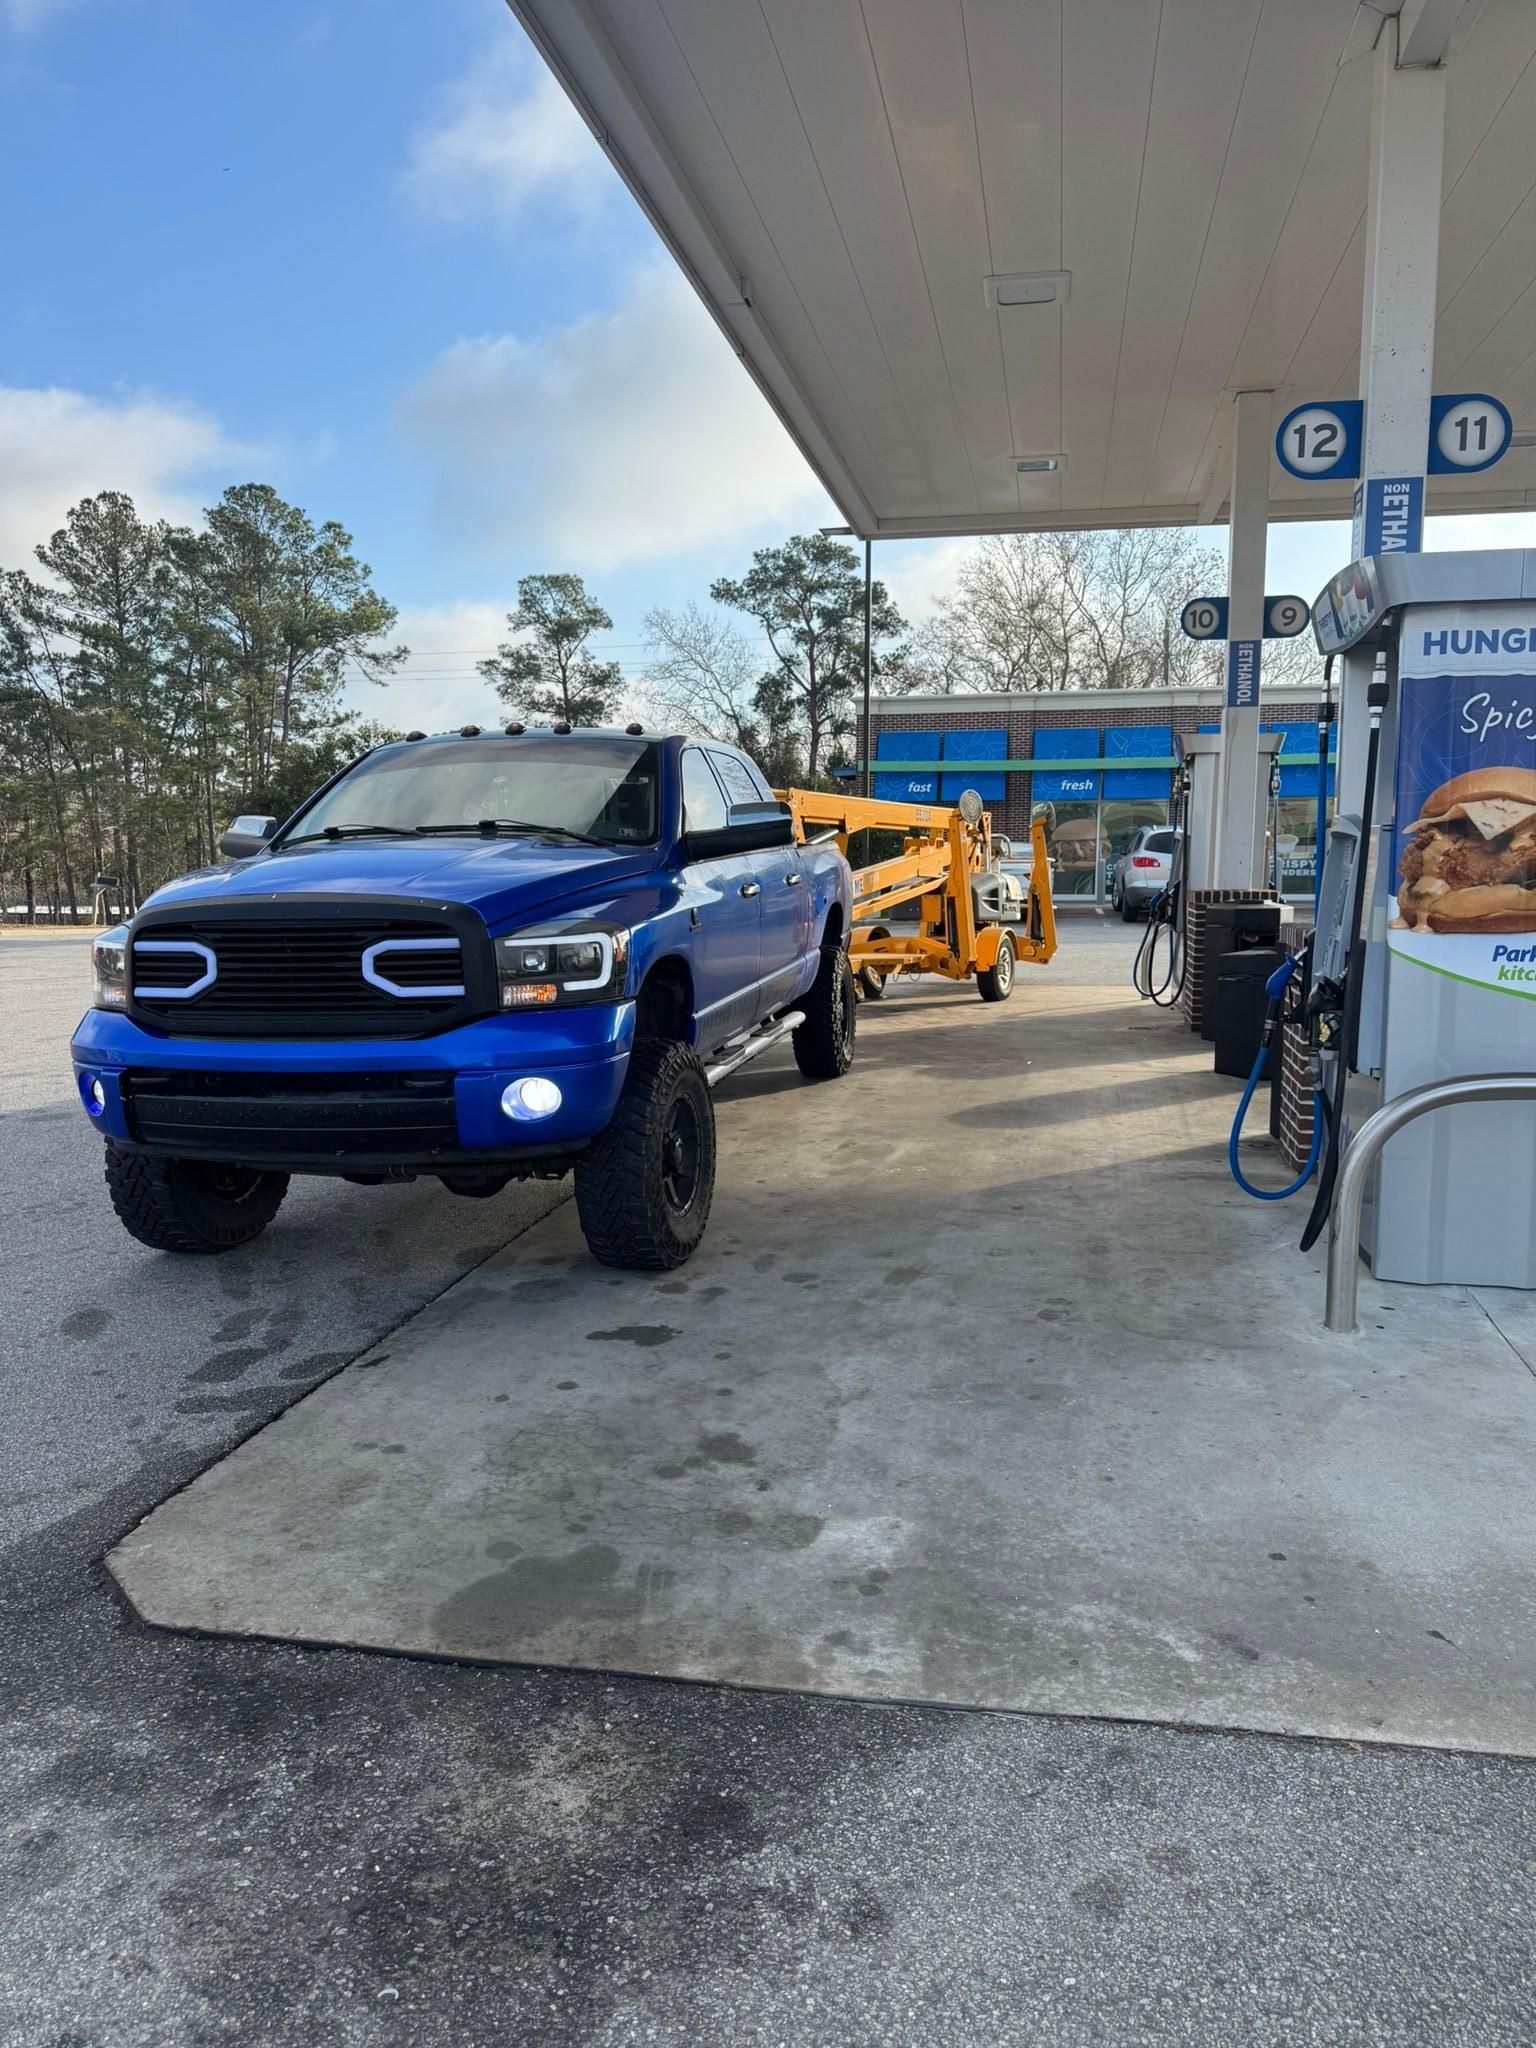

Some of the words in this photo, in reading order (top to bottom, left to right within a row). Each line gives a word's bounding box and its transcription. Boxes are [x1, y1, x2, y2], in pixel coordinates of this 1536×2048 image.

[1293, 423, 1338, 458] 12
[1454, 416, 1487, 451] 11
[1383, 483, 1410, 494] NON
[1381, 494, 1409, 555] ETHA
[1190, 609, 1214, 629] 10
[1281, 607, 1297, 626] 9
[1236, 650, 1253, 705] ETHANOL
[1461, 693, 1536, 743] Spic
[908, 781, 932, 792] fast
[1061, 779, 1093, 790] fresh
[1498, 965, 1536, 980] kitc
